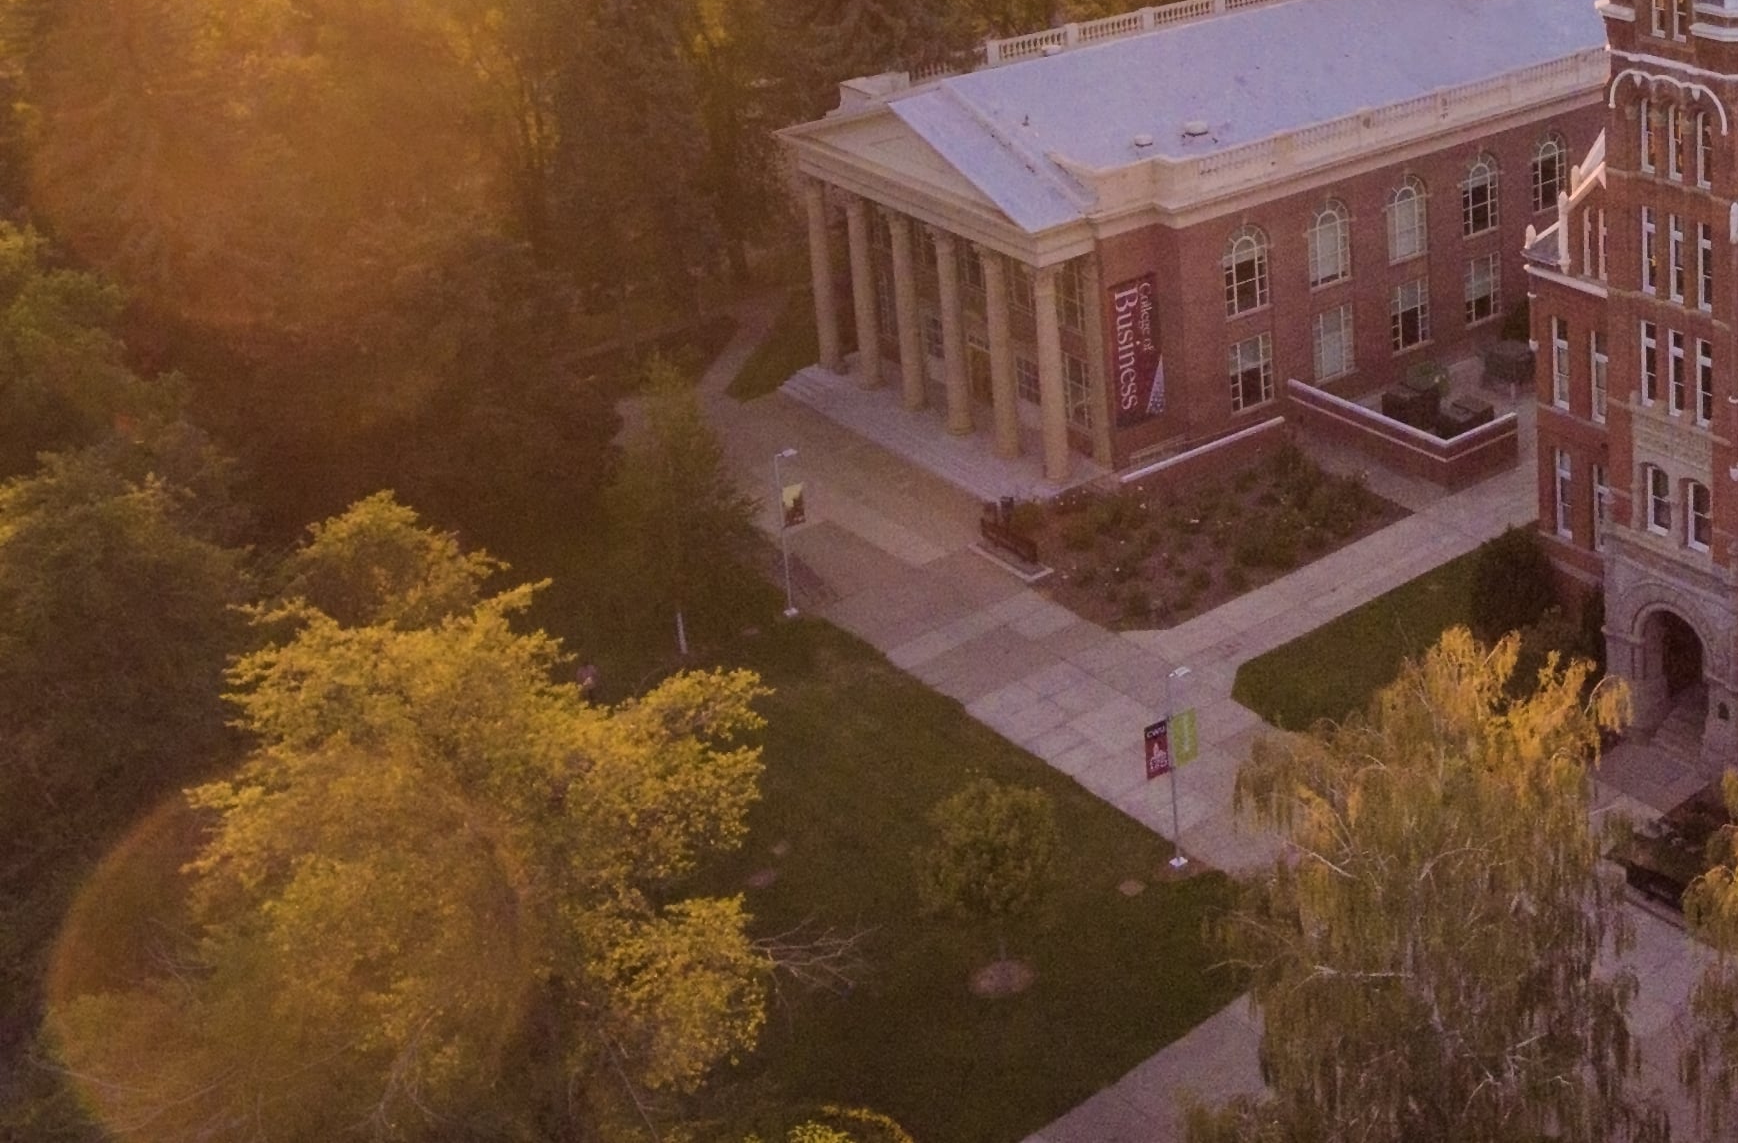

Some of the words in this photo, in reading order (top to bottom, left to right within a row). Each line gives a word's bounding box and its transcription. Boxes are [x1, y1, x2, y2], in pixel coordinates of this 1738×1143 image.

[1139, 282, 1153, 335] College
[1114, 287, 1140, 410] Business
[1143, 338, 1155, 352] of
[1146, 724, 1166, 738] CWU
